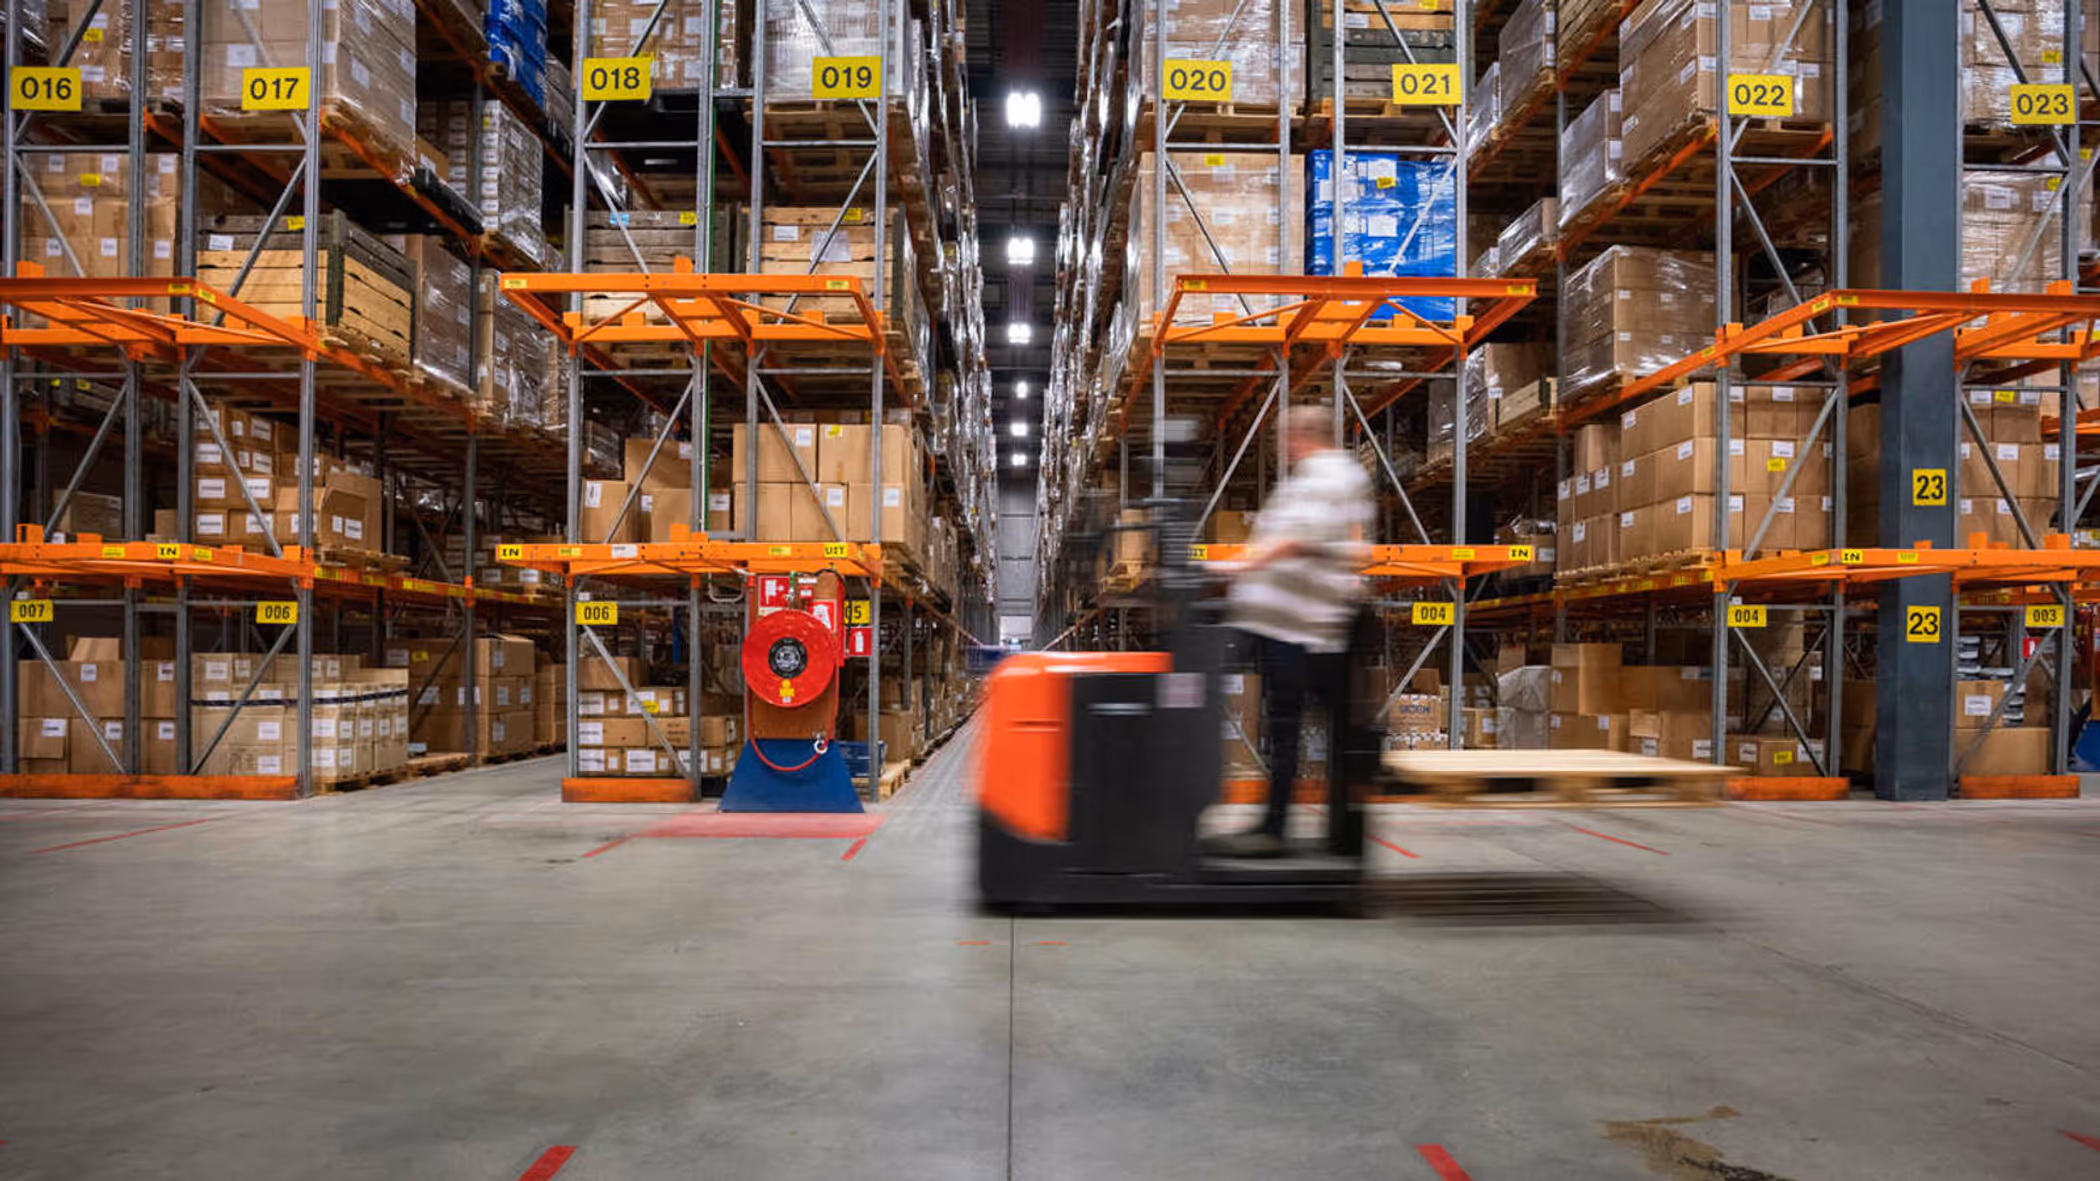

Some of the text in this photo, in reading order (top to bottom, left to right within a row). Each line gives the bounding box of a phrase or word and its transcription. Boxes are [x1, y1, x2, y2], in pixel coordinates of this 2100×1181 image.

[590, 66, 640, 91] 018
[821, 65, 873, 89] 019
[1170, 68, 1226, 92] 020
[1400, 73, 1450, 96] 021
[20, 76, 72, 101] 016
[250, 77, 299, 101] 017
[1734, 83, 1785, 107] 022
[2016, 93, 2069, 116] 023
[1916, 475, 1944, 501] 23
[160, 547, 177, 556] IN
[501, 547, 519, 557] IN
[824, 546, 845, 556] UIT
[1511, 548, 1529, 558] IN
[1843, 552, 1860, 562] IN
[19, 603, 45, 618] 007
[264, 605, 290, 620] 006
[583, 605, 610, 621] 006
[1420, 606, 1446, 621] 004
[1734, 608, 1759, 623] 004
[2032, 608, 2057, 623] 003
[1909, 612, 1938, 636] 23
